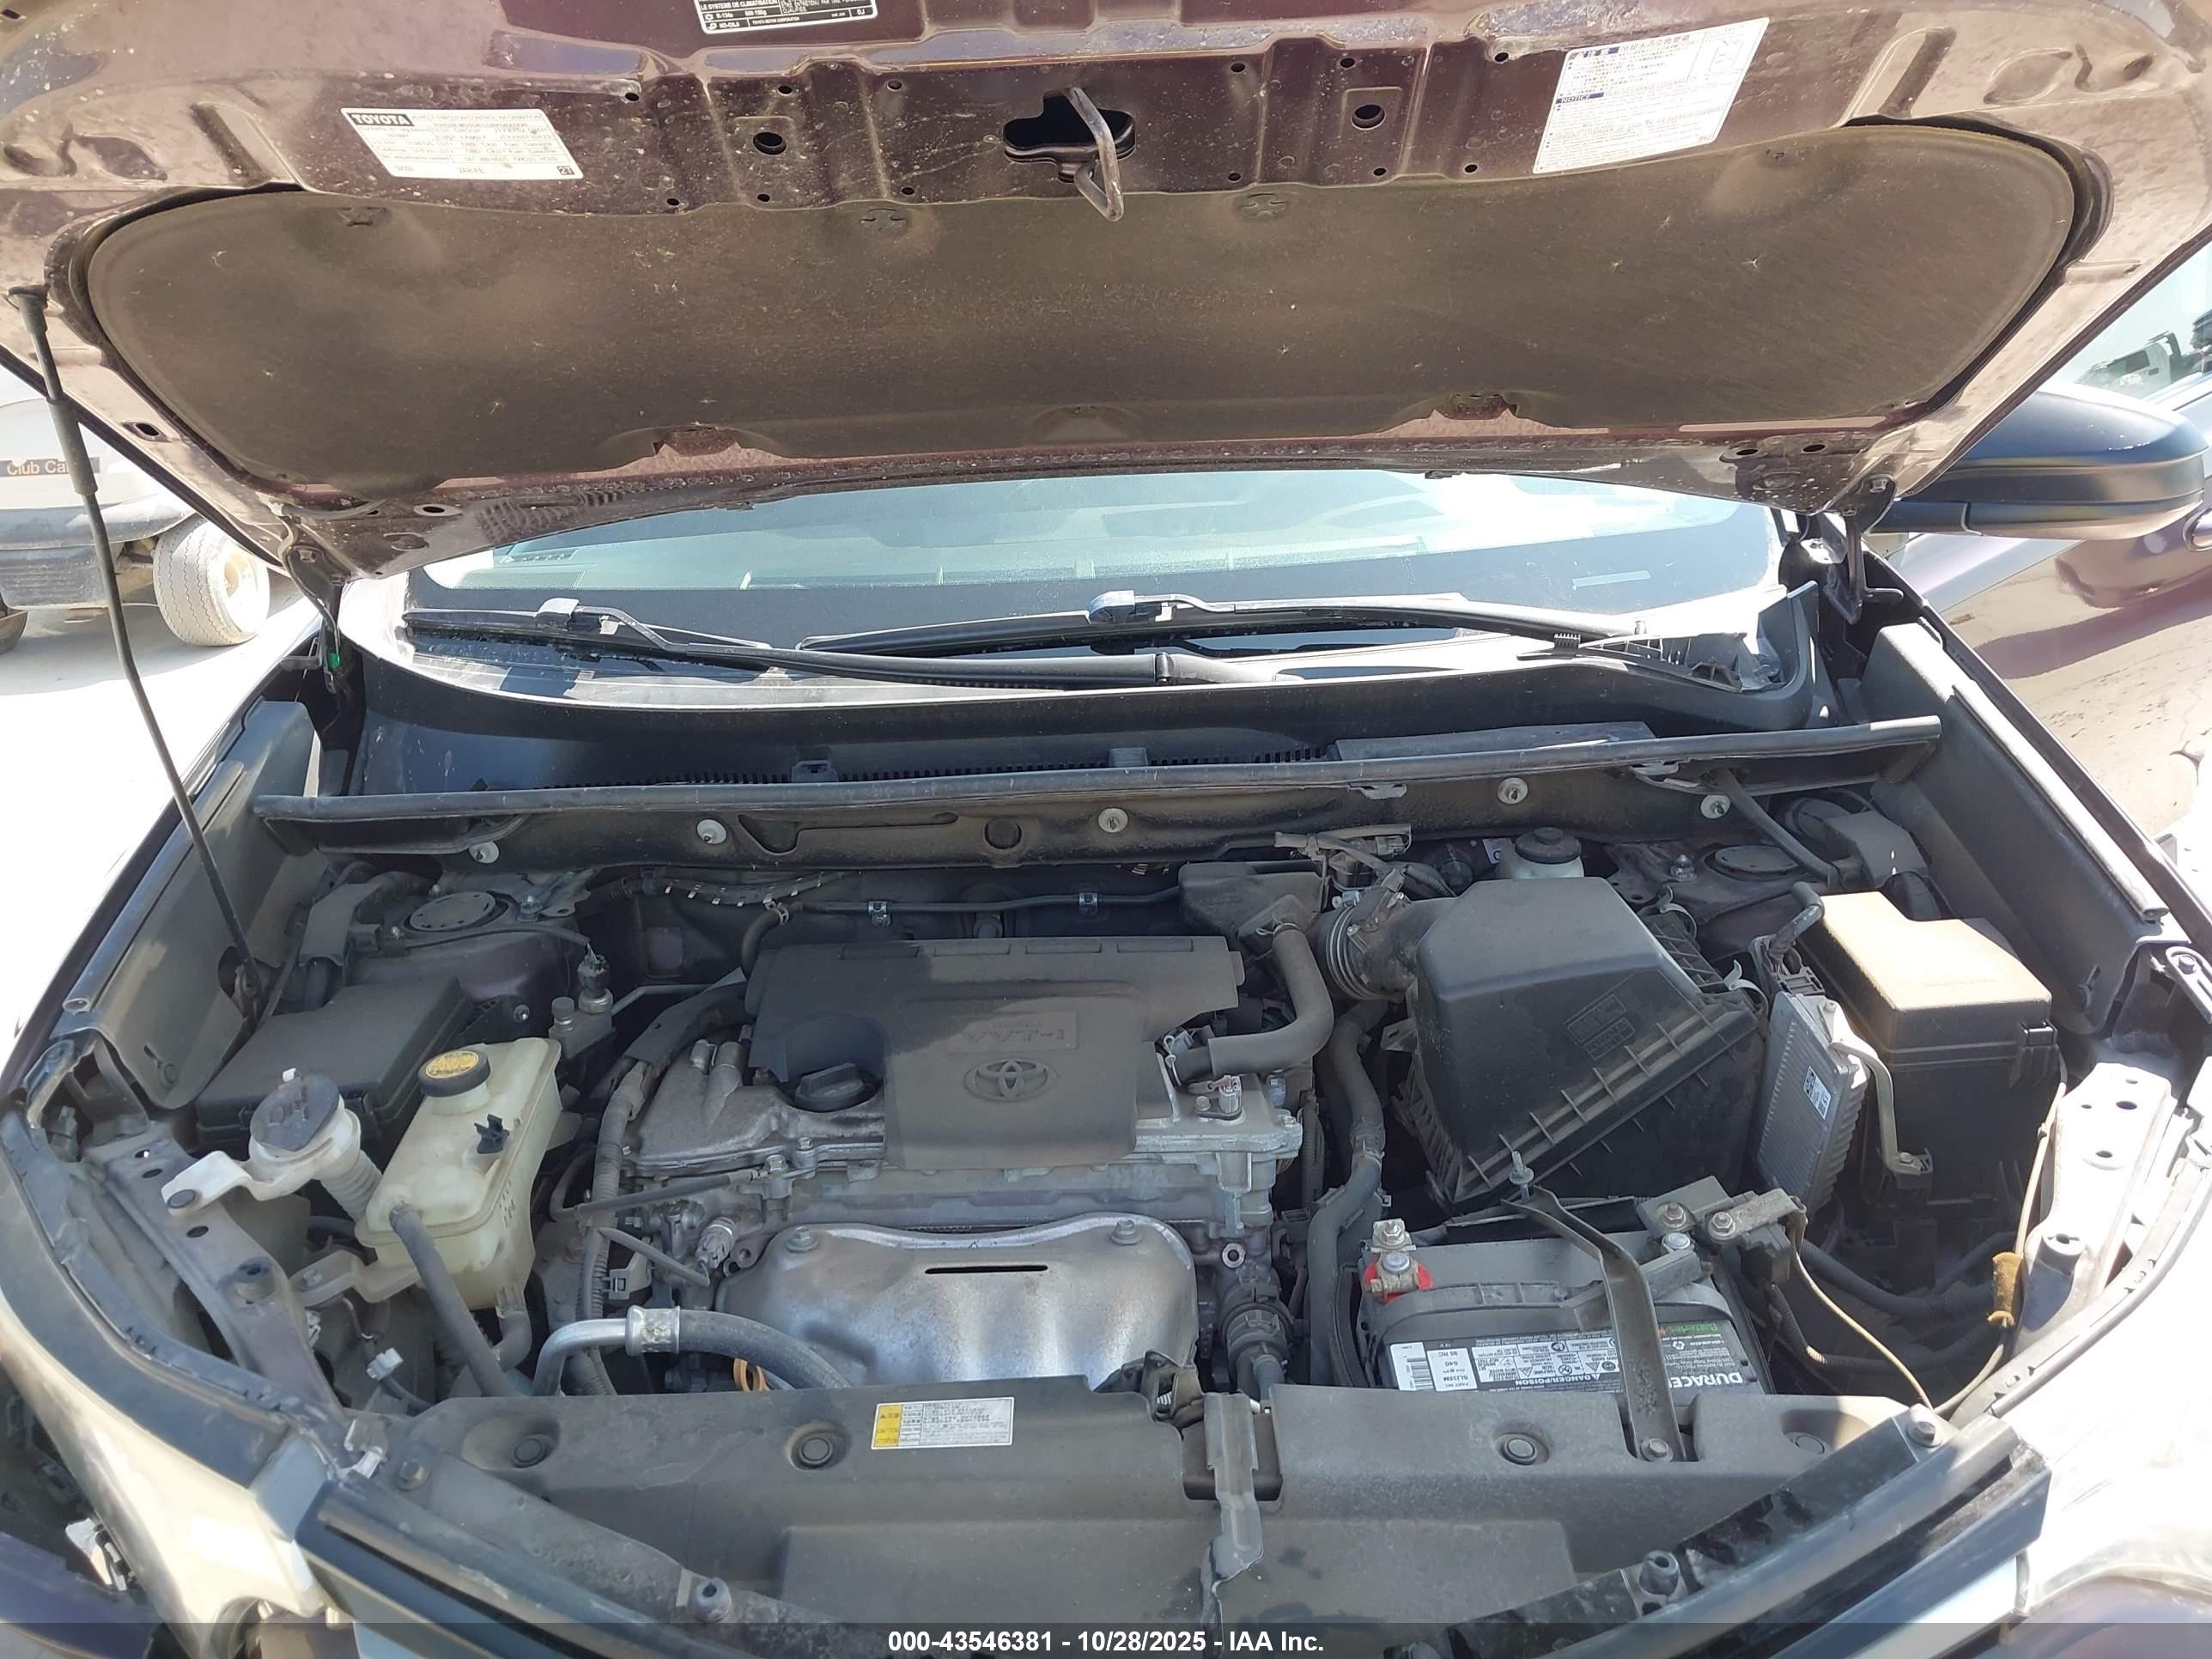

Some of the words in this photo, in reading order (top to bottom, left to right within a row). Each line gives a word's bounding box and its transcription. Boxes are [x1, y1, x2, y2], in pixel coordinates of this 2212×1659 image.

[350, 113, 411, 125] TOYOTA
[45, 459, 70, 474] Ca
[1515, 1374, 1591, 1386] DANGER/POISON
[1668, 1371, 1743, 1389] DURACE
